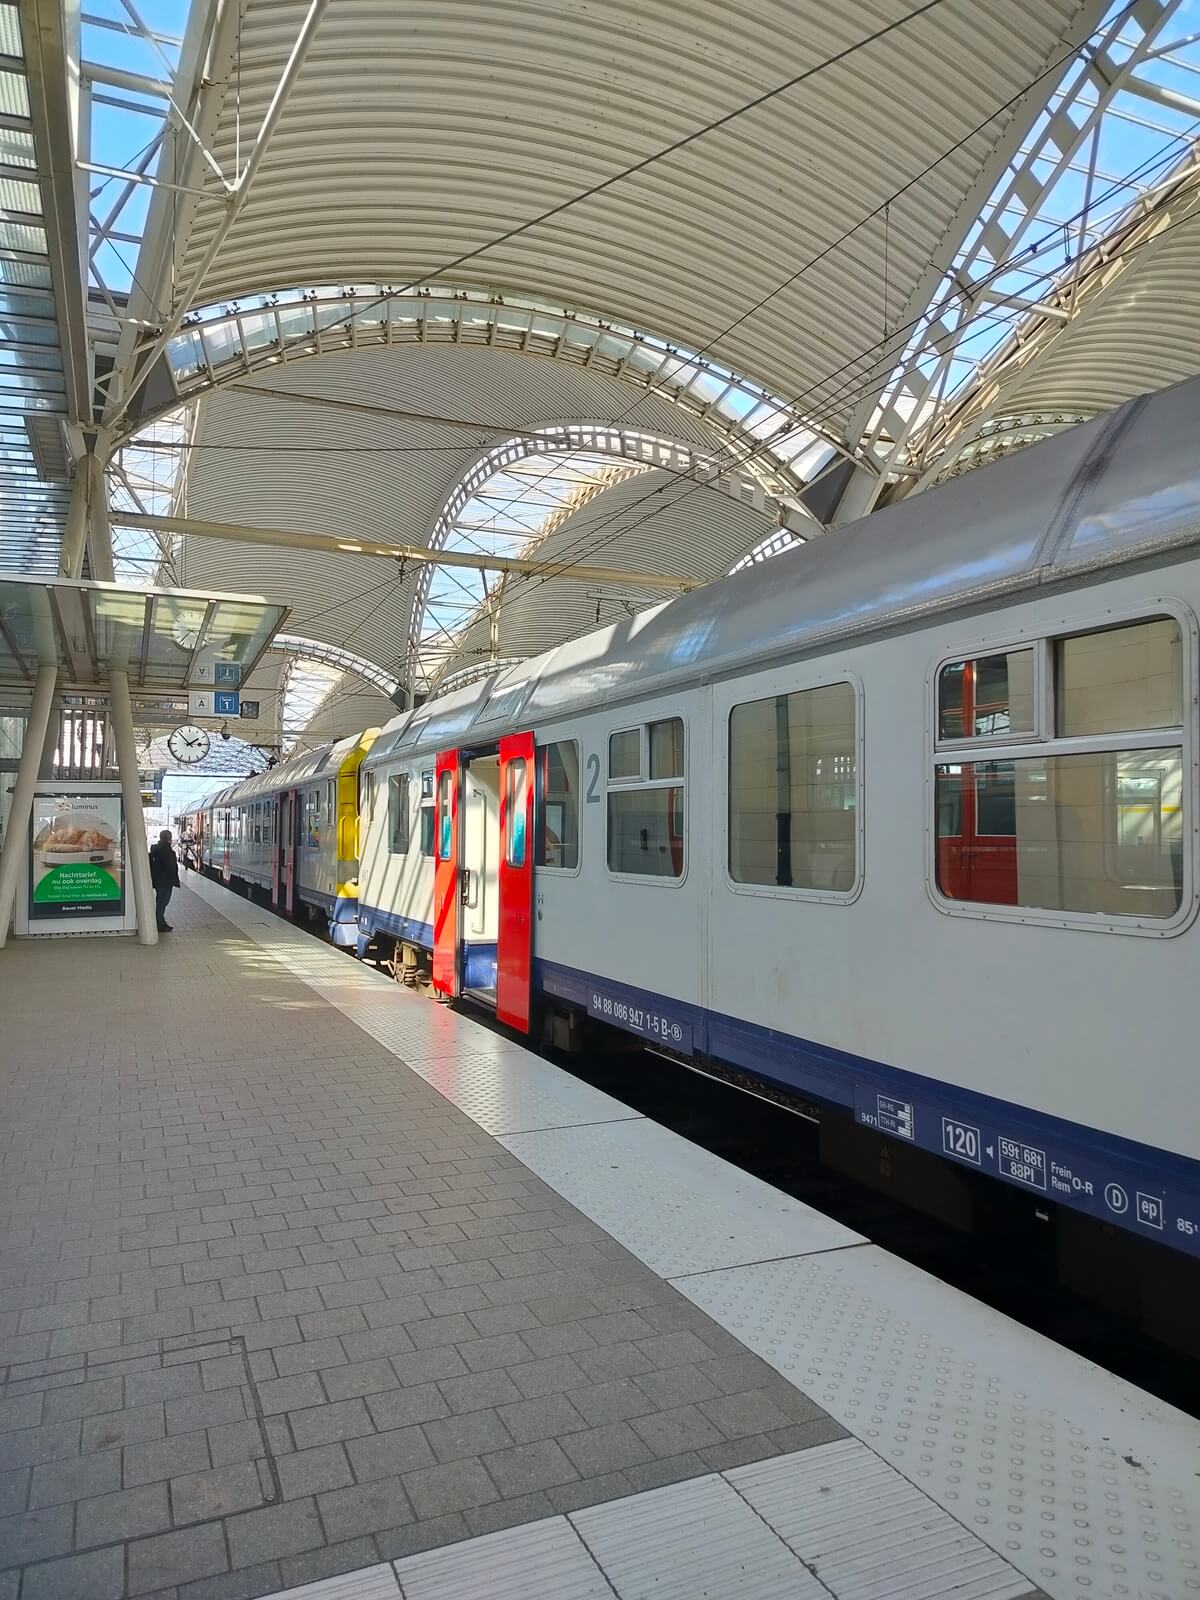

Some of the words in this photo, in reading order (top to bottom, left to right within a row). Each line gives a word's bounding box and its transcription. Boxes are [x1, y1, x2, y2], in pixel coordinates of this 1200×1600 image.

[198, 699, 206, 708] A
[224, 701, 230, 711] 1
[586, 753, 601, 804] 2
[59, 871, 97, 879] Nachttarief
[75, 877, 103, 886] overdag
[592, 994, 602, 1011] 94
[603, 998, 613, 1015] 88
[613, 1002, 628, 1020] 086
[628, 1007, 644, 1027] 947
[646, 1013, 659, 1033] 1-5
[861, 1112, 878, 1126] 9471
[946, 1124, 977, 1157] 120
[1001, 1140, 1020, 1160] 59t
[1023, 1148, 1043, 1168] 68t
[1051, 1161, 1073, 1180] Frein
[1051, 1175, 1072, 1194] Rem
[1072, 1176, 1094, 1196] O-R
[1112, 1188, 1122, 1208] D
[1141, 1199, 1158, 1220] ep
